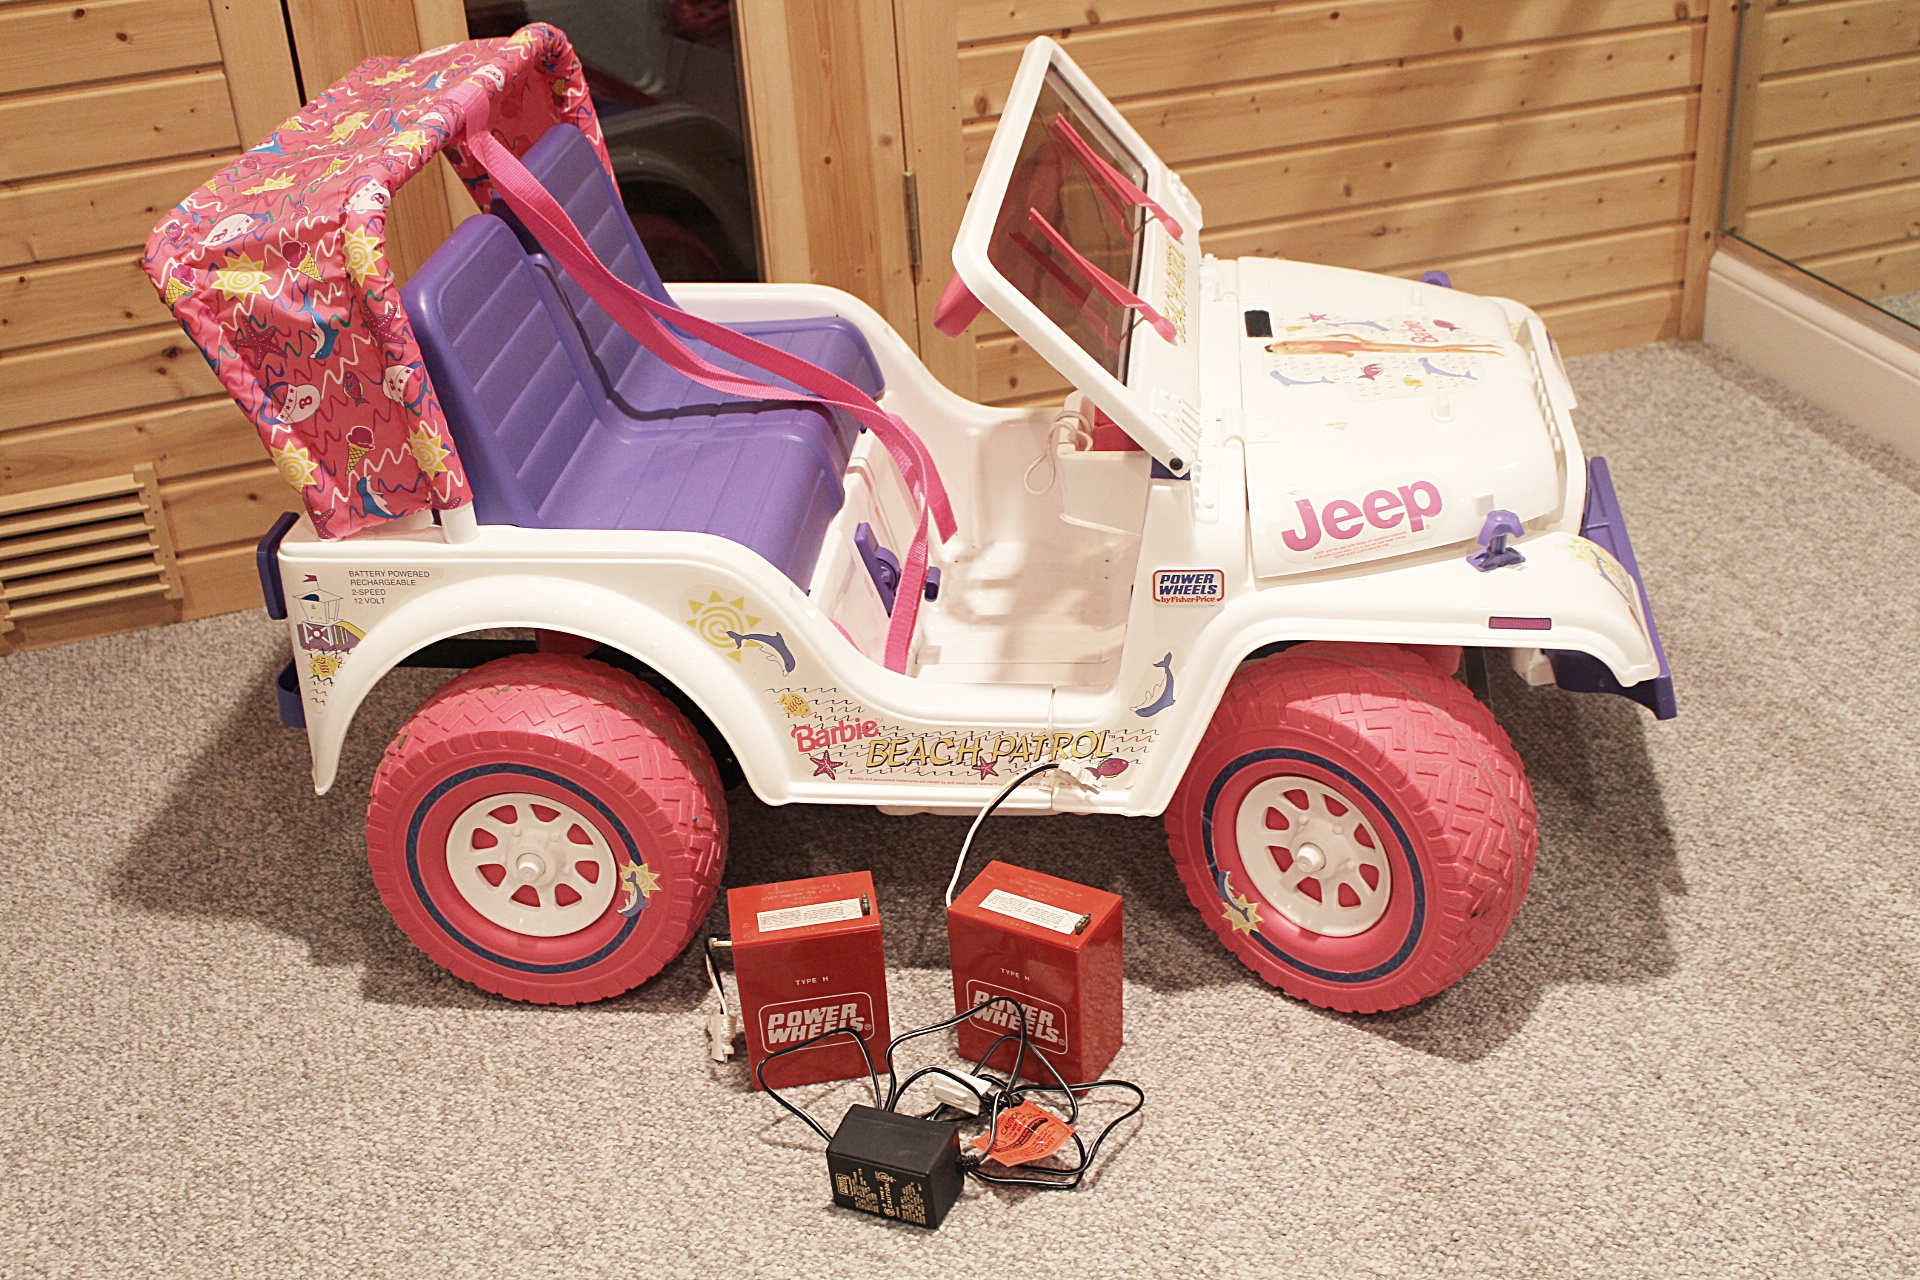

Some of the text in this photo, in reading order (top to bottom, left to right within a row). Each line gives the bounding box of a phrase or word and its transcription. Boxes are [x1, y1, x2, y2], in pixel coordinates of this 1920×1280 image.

[299, 395, 312, 409] B
[1281, 480, 1443, 551] Jeep
[348, 570, 430, 578] BATTERY POWERED
[1159, 573, 1215, 585] POWER
[351, 588, 387, 596] 2-SPEED
[1159, 584, 1218, 595] WHEELS
[353, 597, 386, 605] 12 VOLT
[1160, 595, 1216, 604] by Fisher-Price
[790, 717, 880, 753] Barbie
[865, 730, 1114, 768] BEACH PATROL
[795, 977, 818, 986] TYPE
[1000, 967, 1031, 982] TYPE H
[767, 1003, 858, 1030] POWER
[1000, 1111, 1022, 1136] CAUTION
[884, 1182, 893, 1209] CAUTION
